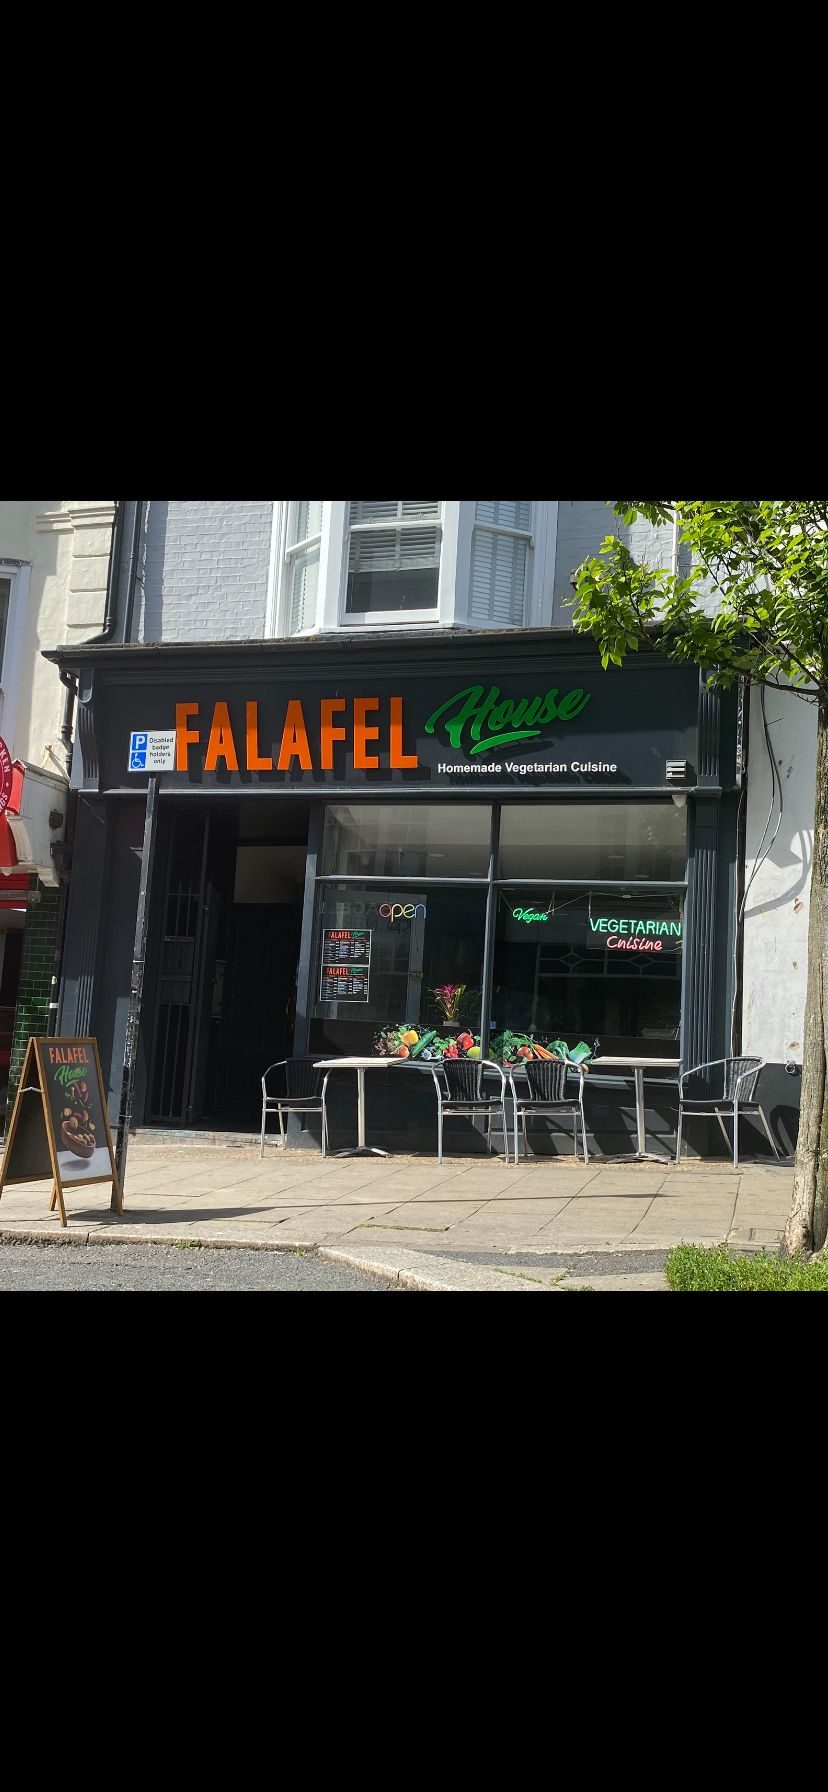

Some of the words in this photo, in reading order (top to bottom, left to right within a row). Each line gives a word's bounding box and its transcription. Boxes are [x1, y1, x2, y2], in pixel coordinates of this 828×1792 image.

[176, 697, 418, 771] FALAFEL
[425, 685, 591, 749] House
[136, 736, 146, 750] P
[437, 762, 502, 774] Homemade
[505, 762, 568, 775] Vegetarian
[570, 761, 618, 773] Cuisine
[379, 903, 426, 922] open
[512, 908, 549, 924] Vegan
[589, 918, 681, 936] VEGETARIAN
[606, 935, 663, 951] Cuisine
[49, 1047, 89, 1064] FALAFEL
[54, 1065, 88, 1086] House
